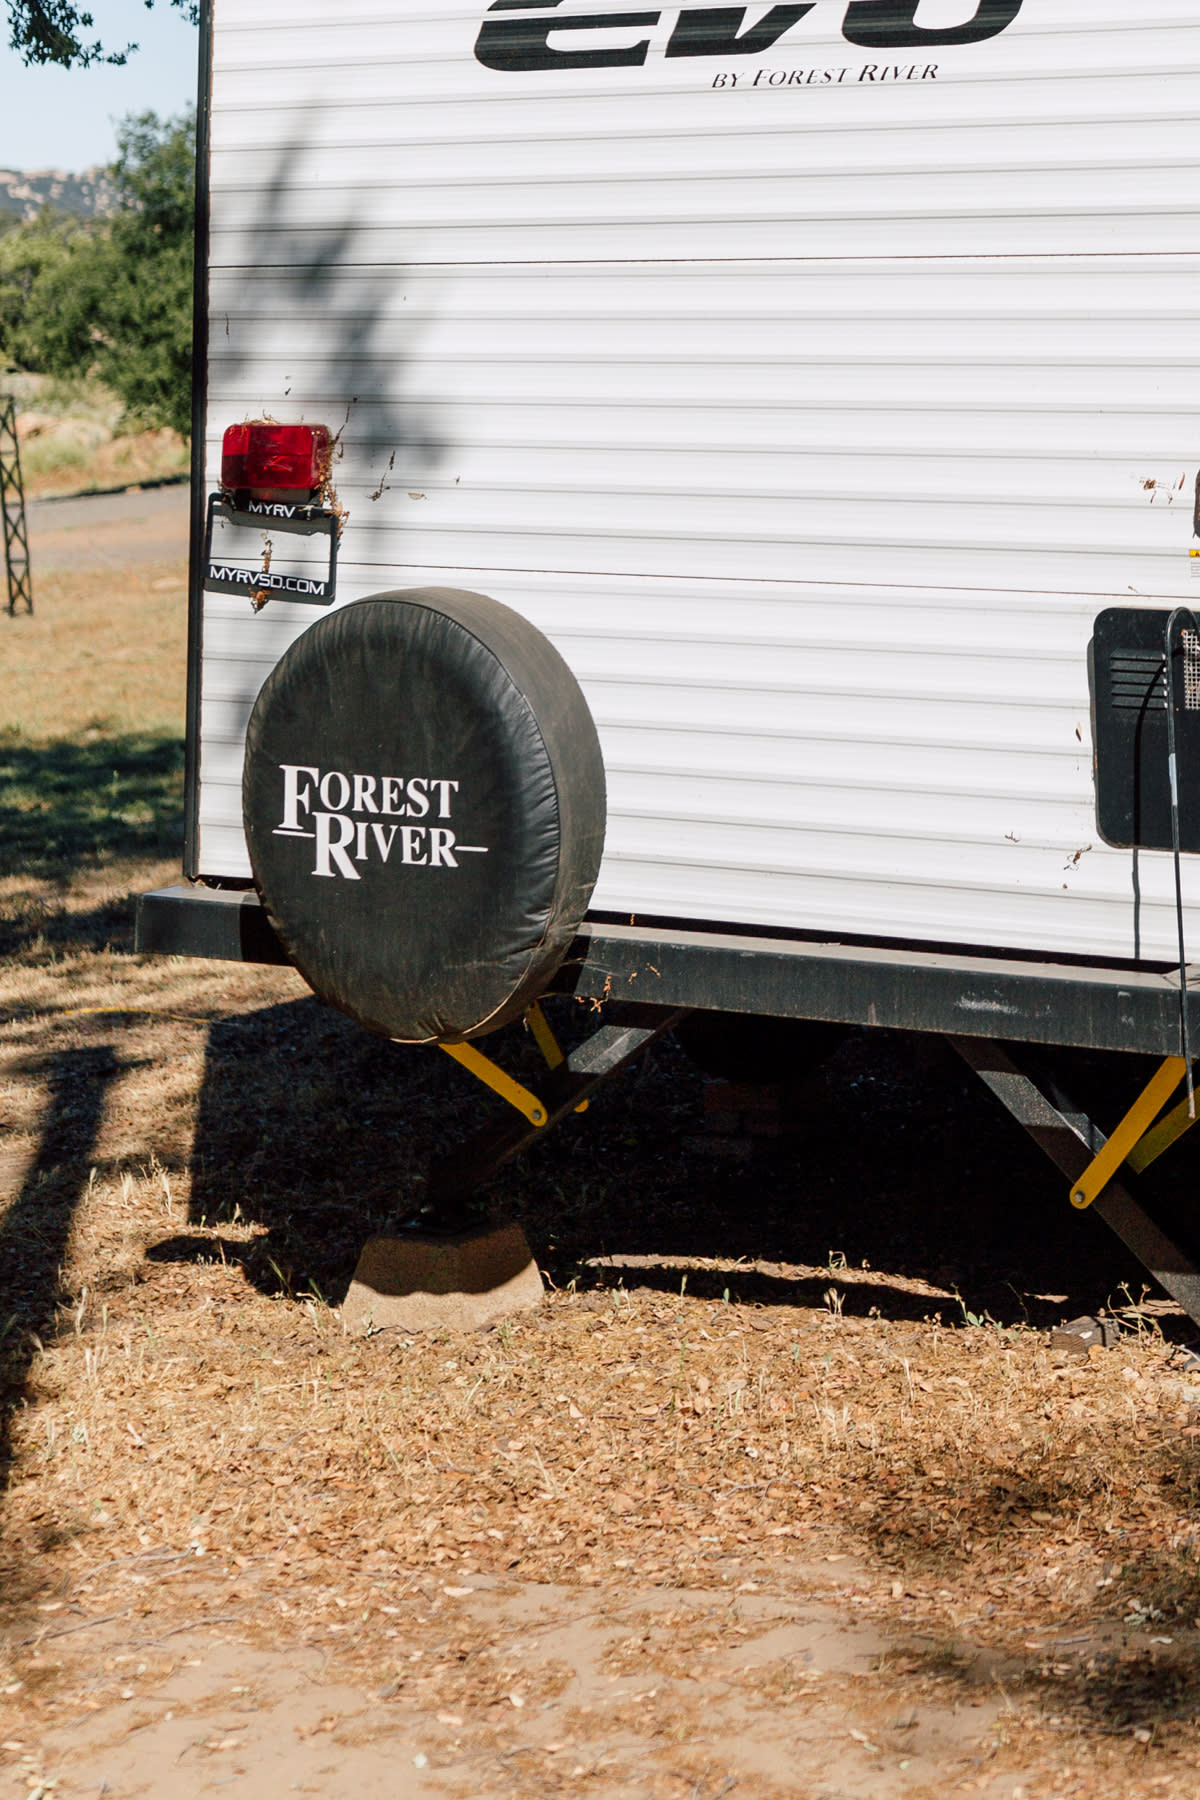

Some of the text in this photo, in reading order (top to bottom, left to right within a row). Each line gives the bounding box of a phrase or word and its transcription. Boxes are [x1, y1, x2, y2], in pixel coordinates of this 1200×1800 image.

[711, 63, 940, 89] BY FOREST RIVER
[248, 500, 297, 520] MYRV
[209, 565, 326, 596] MYRVSD.COM
[278, 764, 459, 830] FOREST
[311, 811, 460, 880] RIVER
